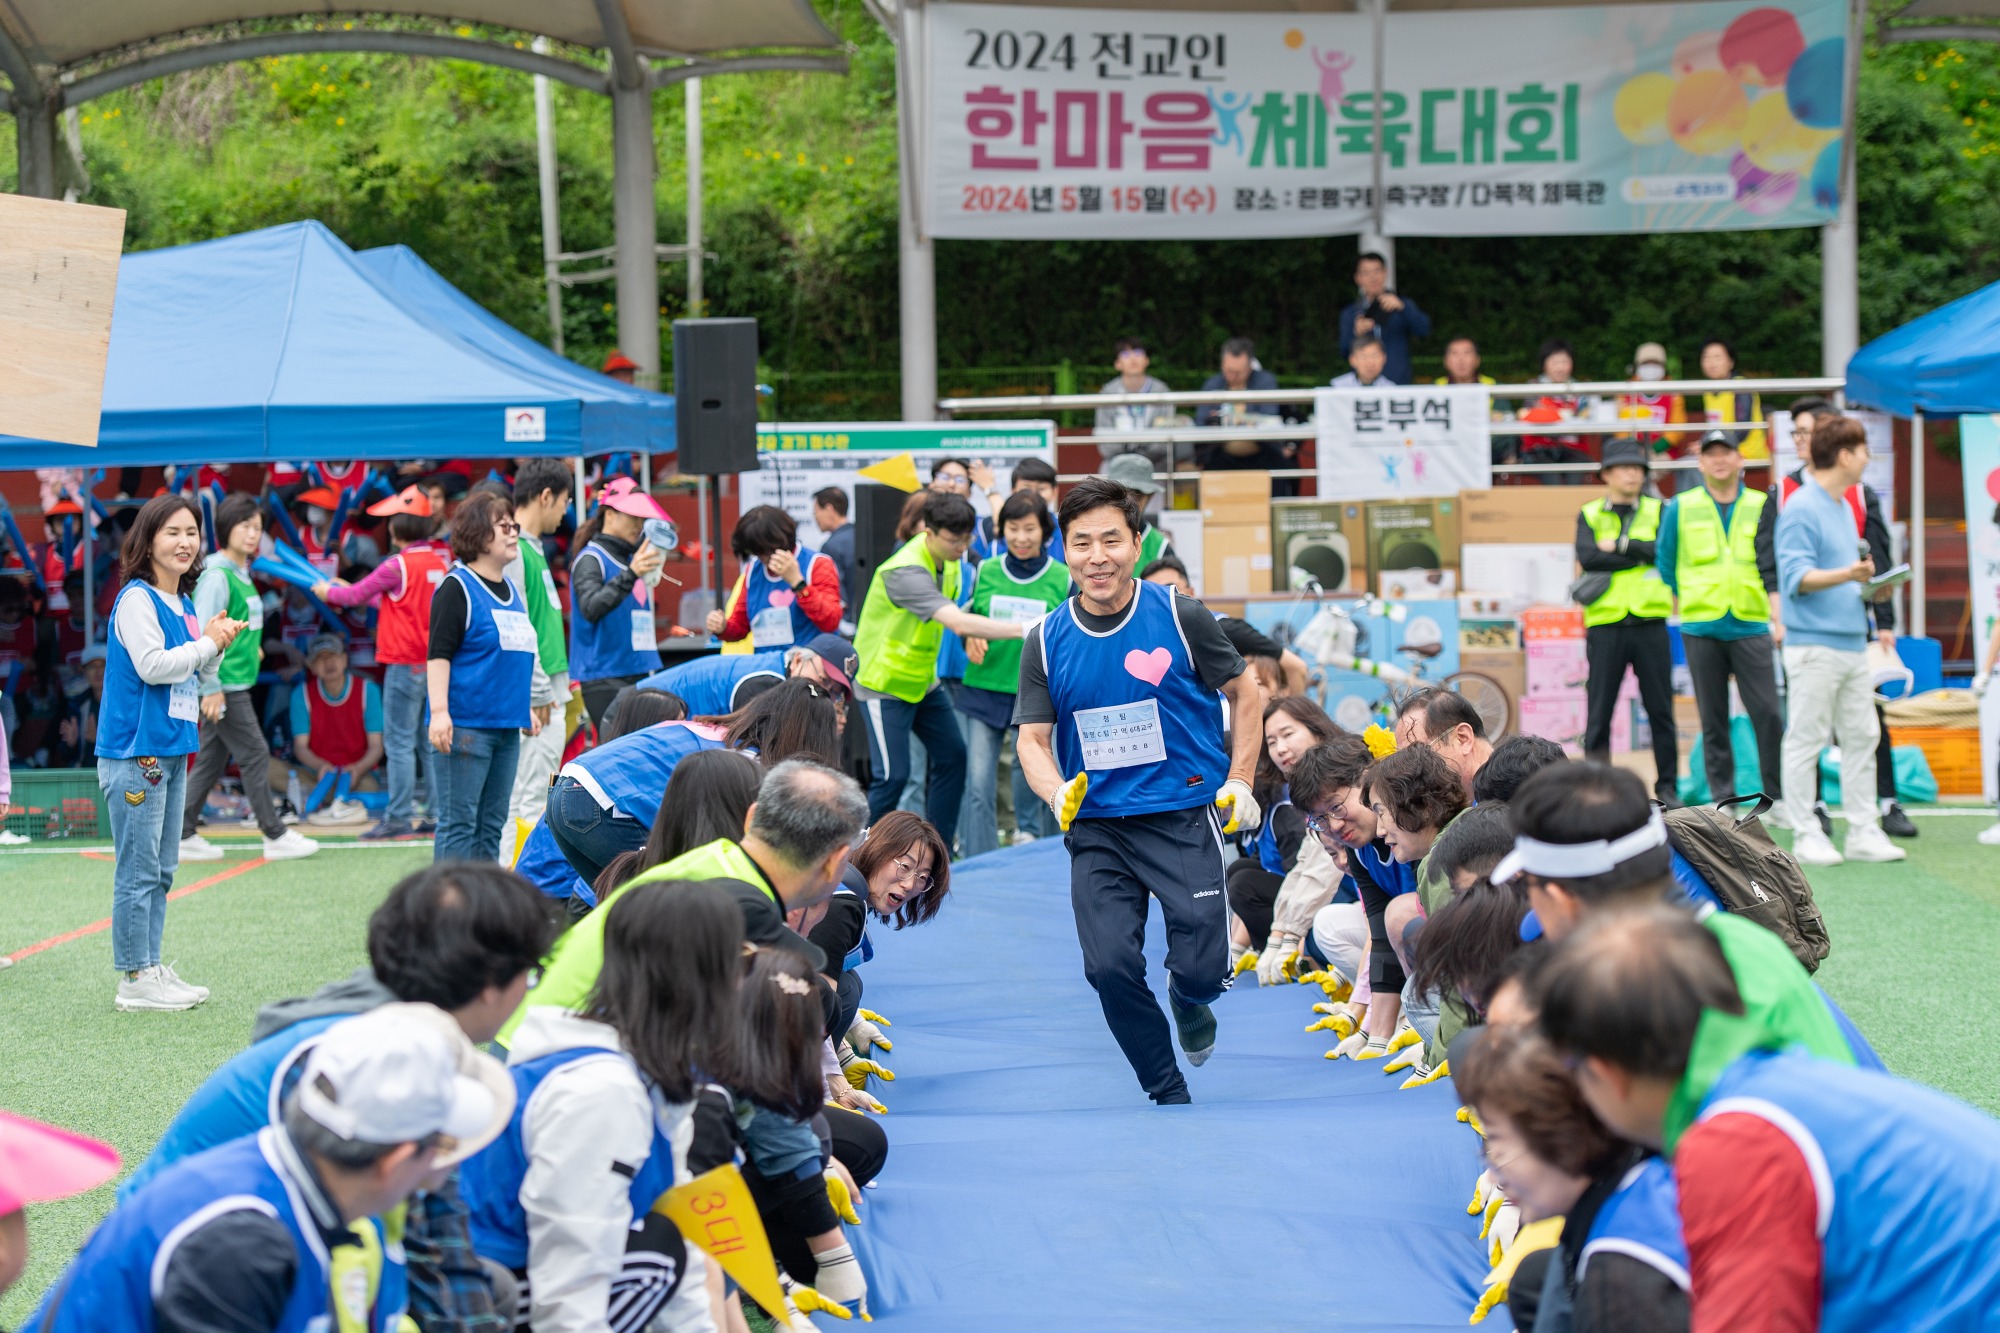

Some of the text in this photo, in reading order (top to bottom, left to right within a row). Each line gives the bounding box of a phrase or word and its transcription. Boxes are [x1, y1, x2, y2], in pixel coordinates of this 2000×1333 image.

[963, 29, 1228, 82] 2024 전교인
[963, 81, 1582, 171] 한마음 체육대회
[962, 184, 1217, 214] 2024년 5월 15일(수)
[1235, 187, 1277, 210] 장소
[1354, 397, 1451, 432] 본부석
[690, 1191, 746, 1257] 3대
